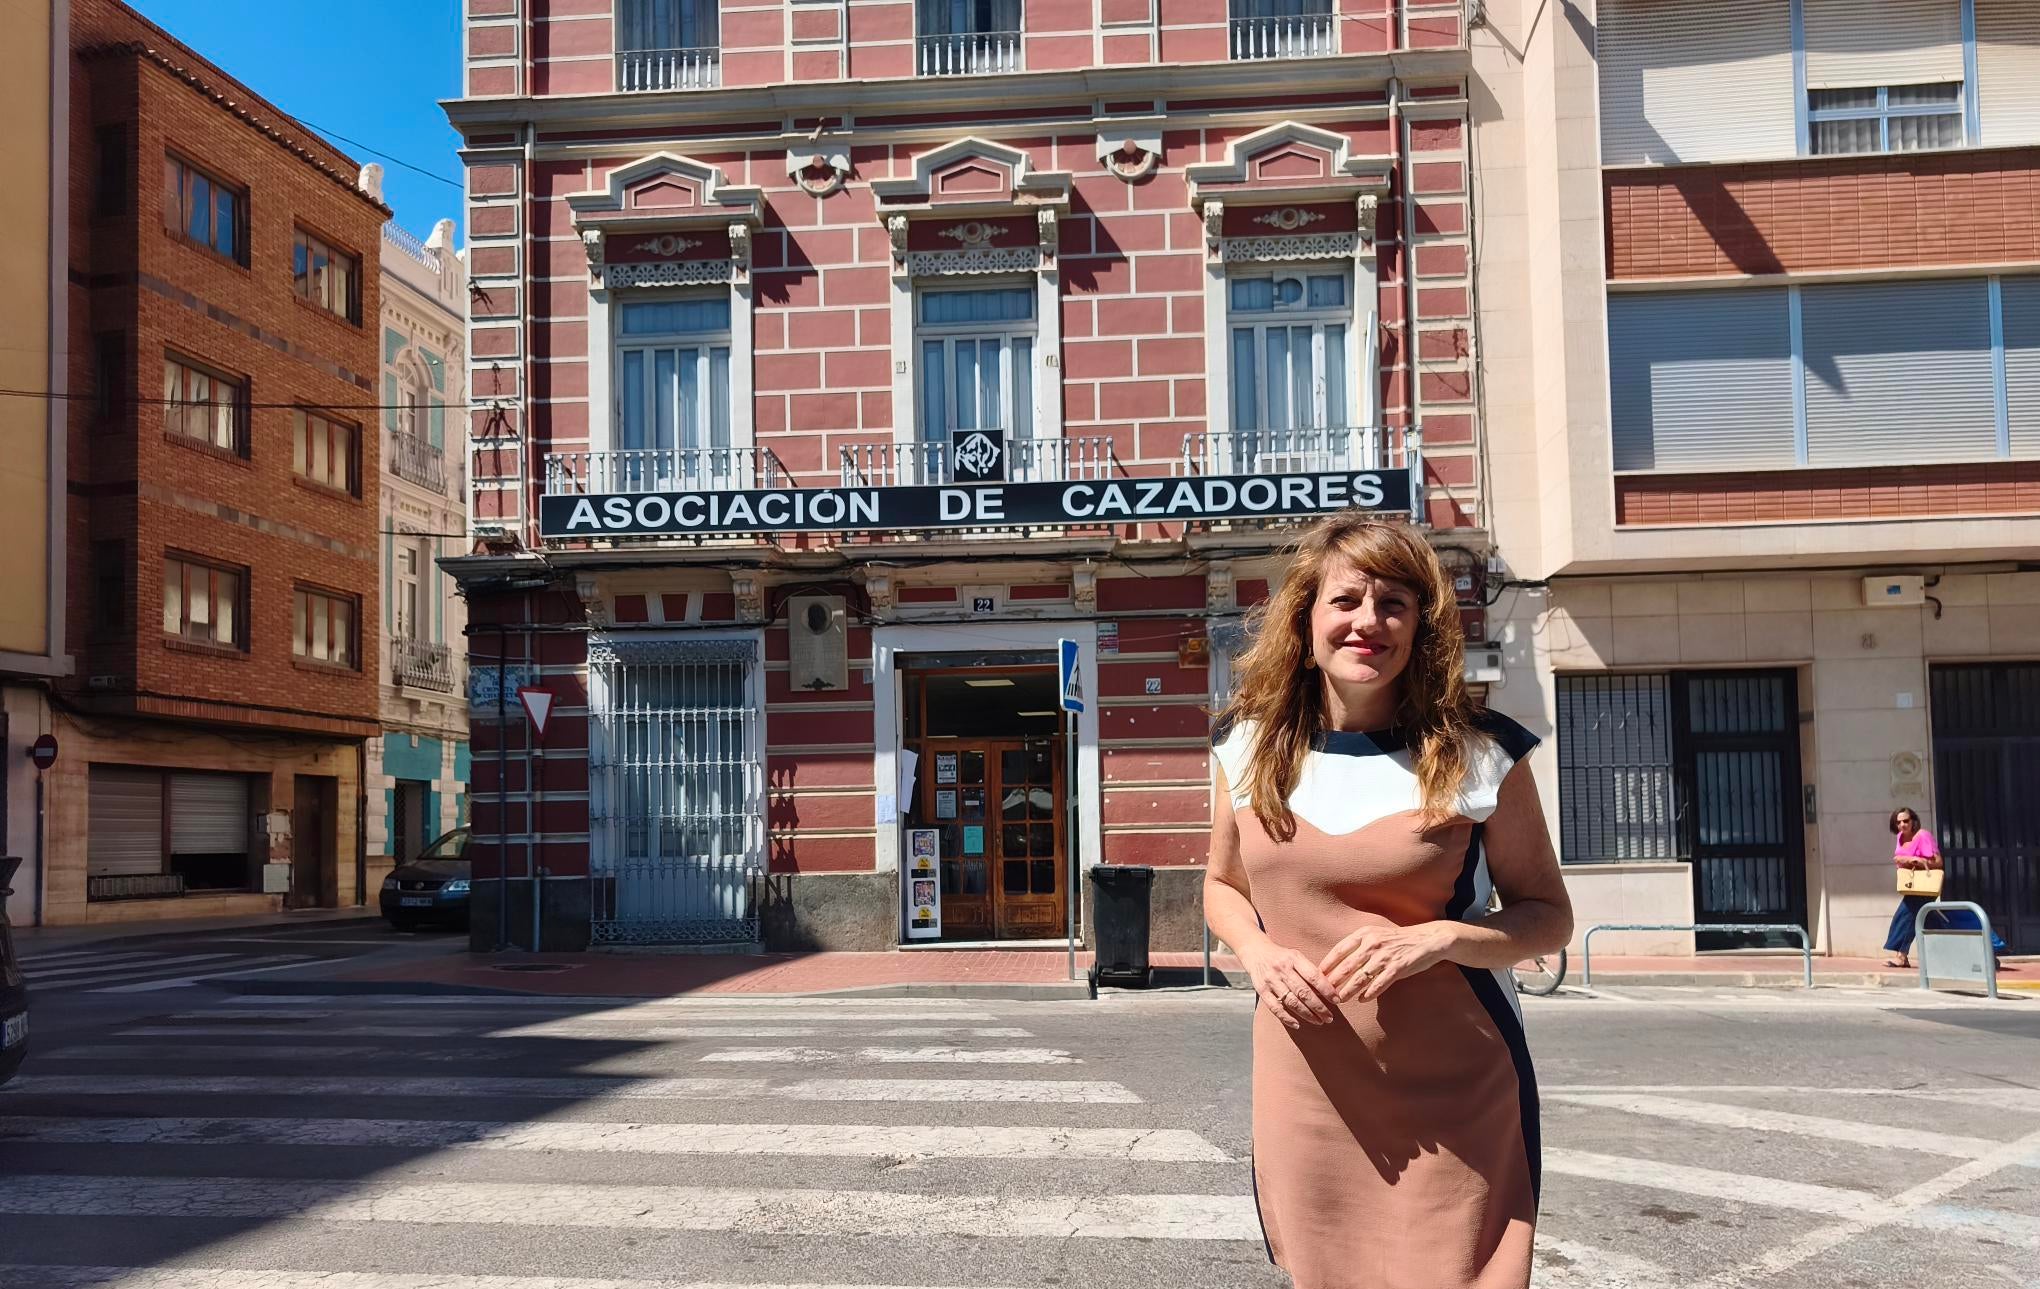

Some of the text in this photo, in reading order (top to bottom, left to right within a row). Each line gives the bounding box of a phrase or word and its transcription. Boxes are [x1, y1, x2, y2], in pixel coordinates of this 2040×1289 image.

[566, 473, 1385, 530] ASOCIACIÓN DE CAZADORES
[977, 599, 991, 611] 22
[1146, 680, 1161, 693] 22
